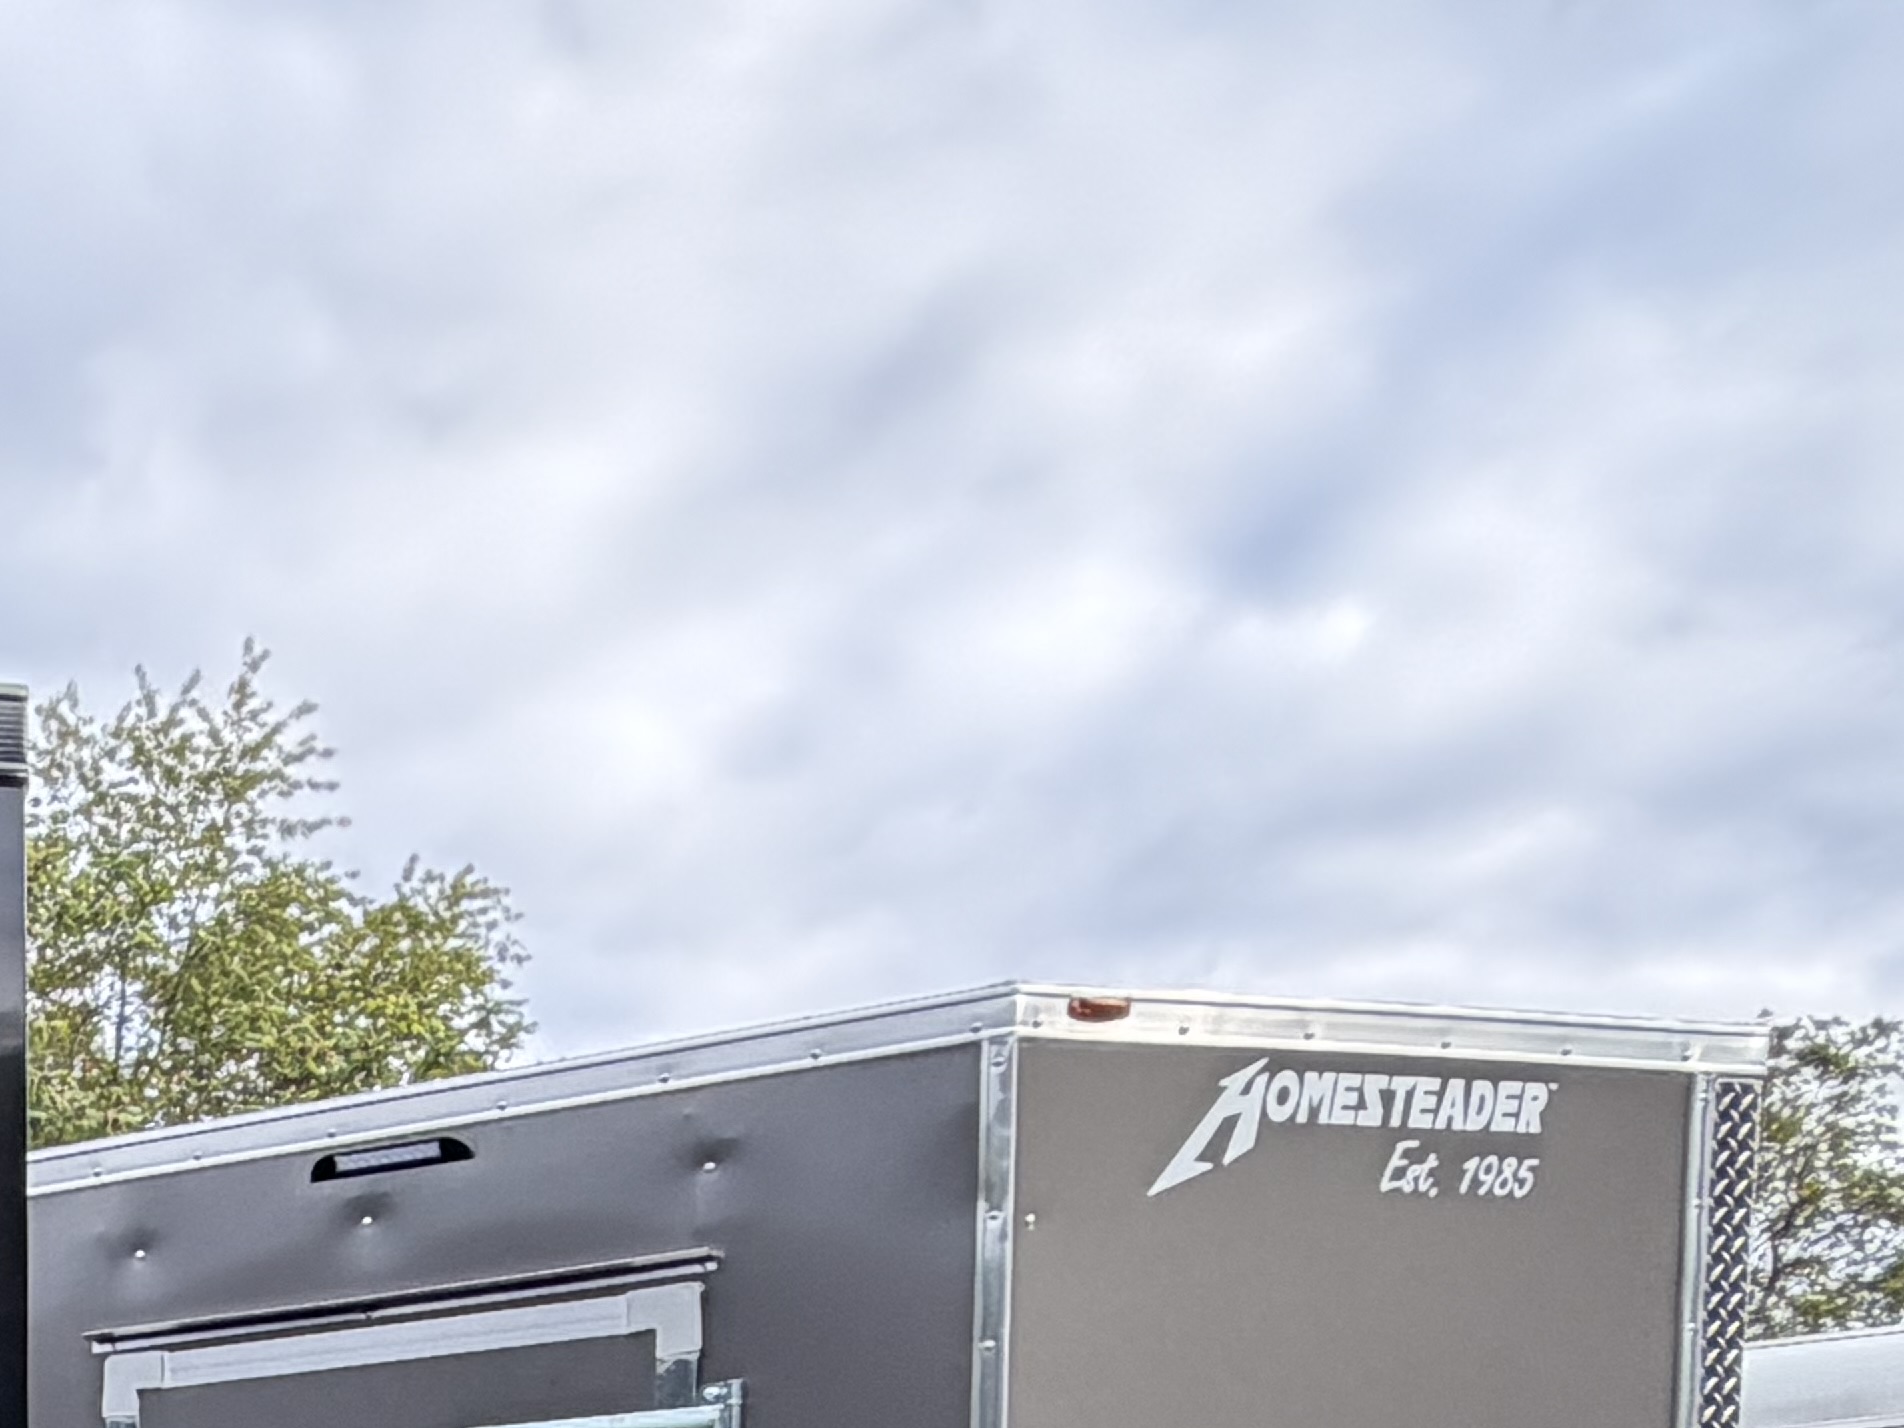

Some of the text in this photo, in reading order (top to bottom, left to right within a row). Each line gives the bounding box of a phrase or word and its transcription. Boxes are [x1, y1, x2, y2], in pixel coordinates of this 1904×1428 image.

[1146, 1056, 1552, 1197] HOMESTEADER
[1379, 1139, 1540, 1199] Est. 1985
